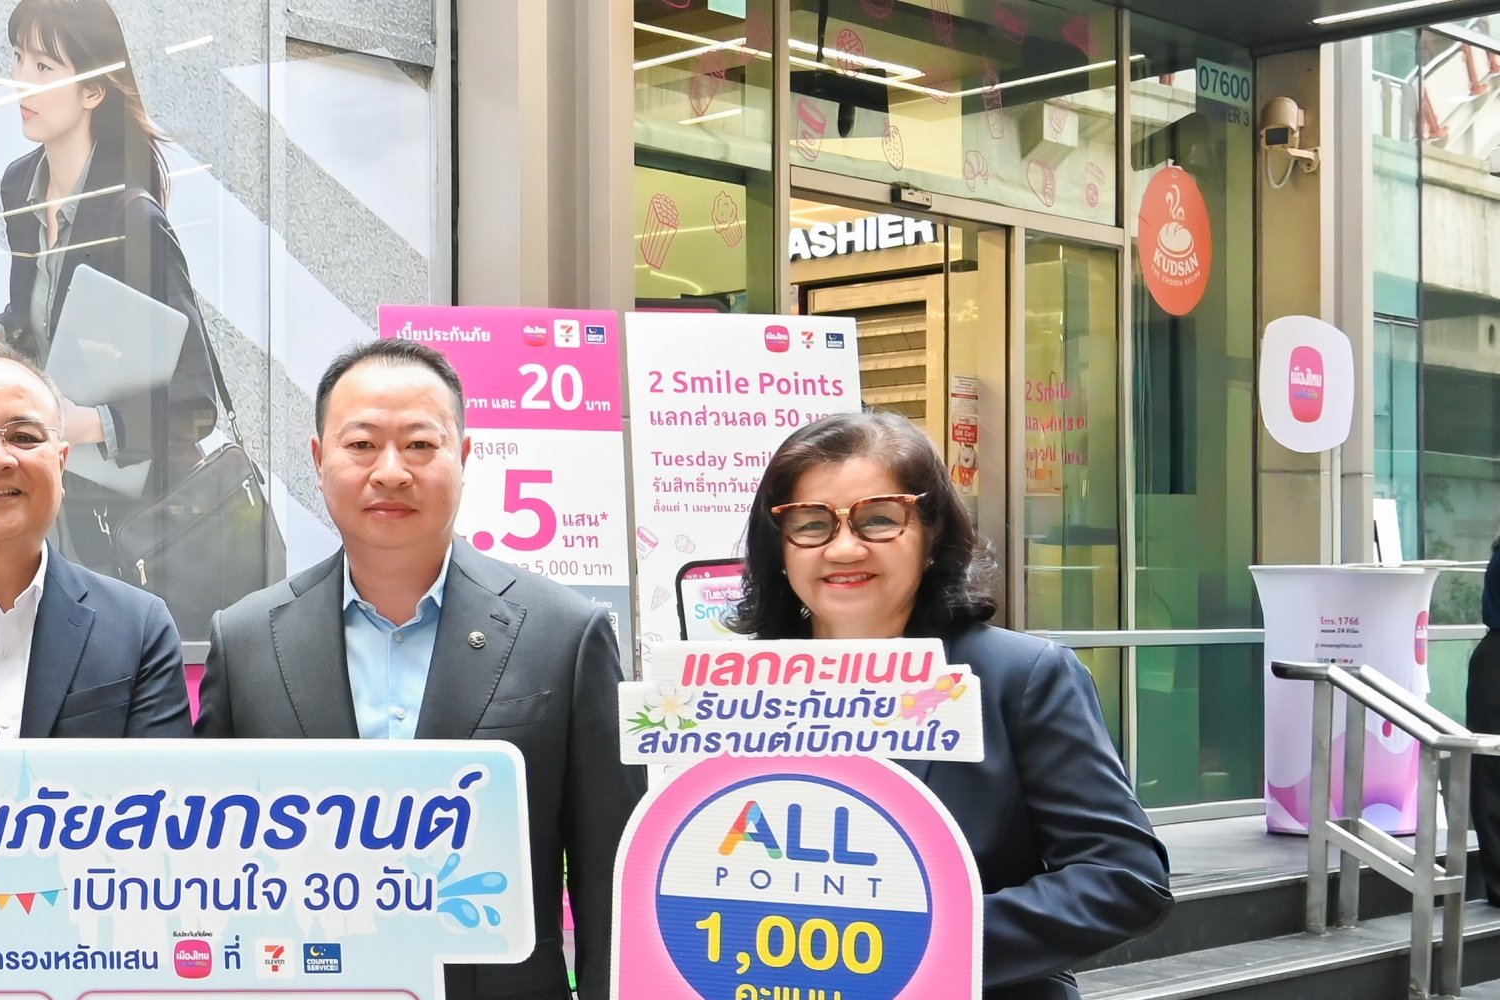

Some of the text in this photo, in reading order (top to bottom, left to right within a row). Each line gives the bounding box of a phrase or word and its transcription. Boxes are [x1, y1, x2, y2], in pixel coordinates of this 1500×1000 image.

[1199, 65, 1250, 102] 07600
[1243, 111, 1250, 127] 3
[1152, 247, 1199, 277] KUDSAN
[491, 397, 516, 410] และ
[518, 363, 583, 411] 20
[585, 399, 611, 412] บาท
[648, 369, 844, 397] 2 Smile Points
[1025, 380, 1032, 401] 2
[650, 405, 766, 427] แลกส่วนลด
[774, 408, 799, 427] 50
[473, 441, 519, 460] สูงสุด
[651, 451, 727, 470] Tuesday
[684, 503, 689, 512] 1
[692, 503, 731, 513] เมษายน
[562, 535, 599, 549] บาท
[535, 560, 579, 578] 5,000
[583, 562, 613, 576] บาท
[1338, 616, 1360, 626] 1766
[681, 651, 934, 687] แลกคะแนน
[695, 688, 896, 722] รับประกันภัย
[637, 719, 961, 754] สงกรานต์เบิกบานใจ
[718, 800, 878, 867] ALL
[72, 862, 434, 912] เบิกบานใจ 30 วัน
[716, 866, 882, 899] POINT
[224, 935, 241, 970] ที่
[695, 911, 883, 976] 1,000
